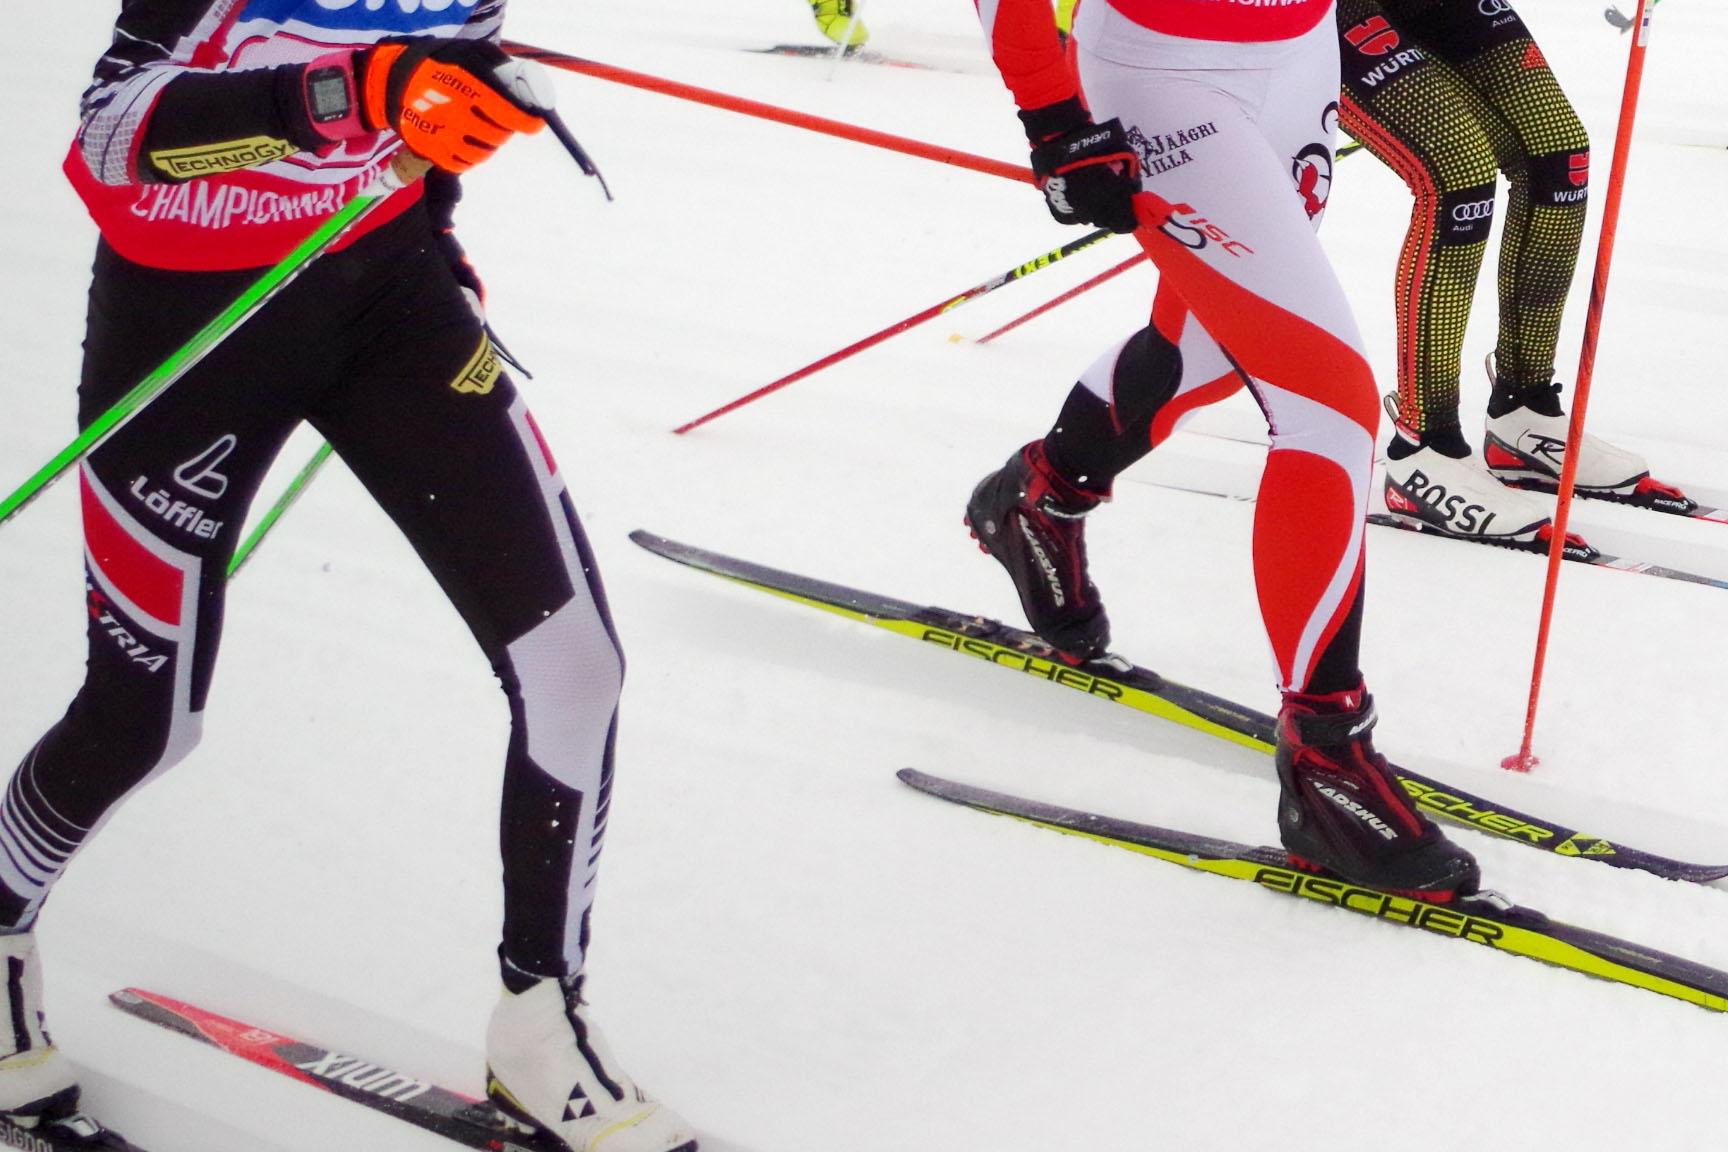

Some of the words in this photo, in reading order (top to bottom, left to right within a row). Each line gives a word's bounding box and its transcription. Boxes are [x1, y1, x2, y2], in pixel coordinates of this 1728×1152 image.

[430, 69, 482, 100] ziener
[1361, 47, 1426, 88] WÜRT
[157, 142, 296, 176] TECHNOGY
[1401, 468, 1497, 535] ROSSI
[922, 629, 1125, 702] FISCHER
[1254, 868, 1505, 946] FISCHER
